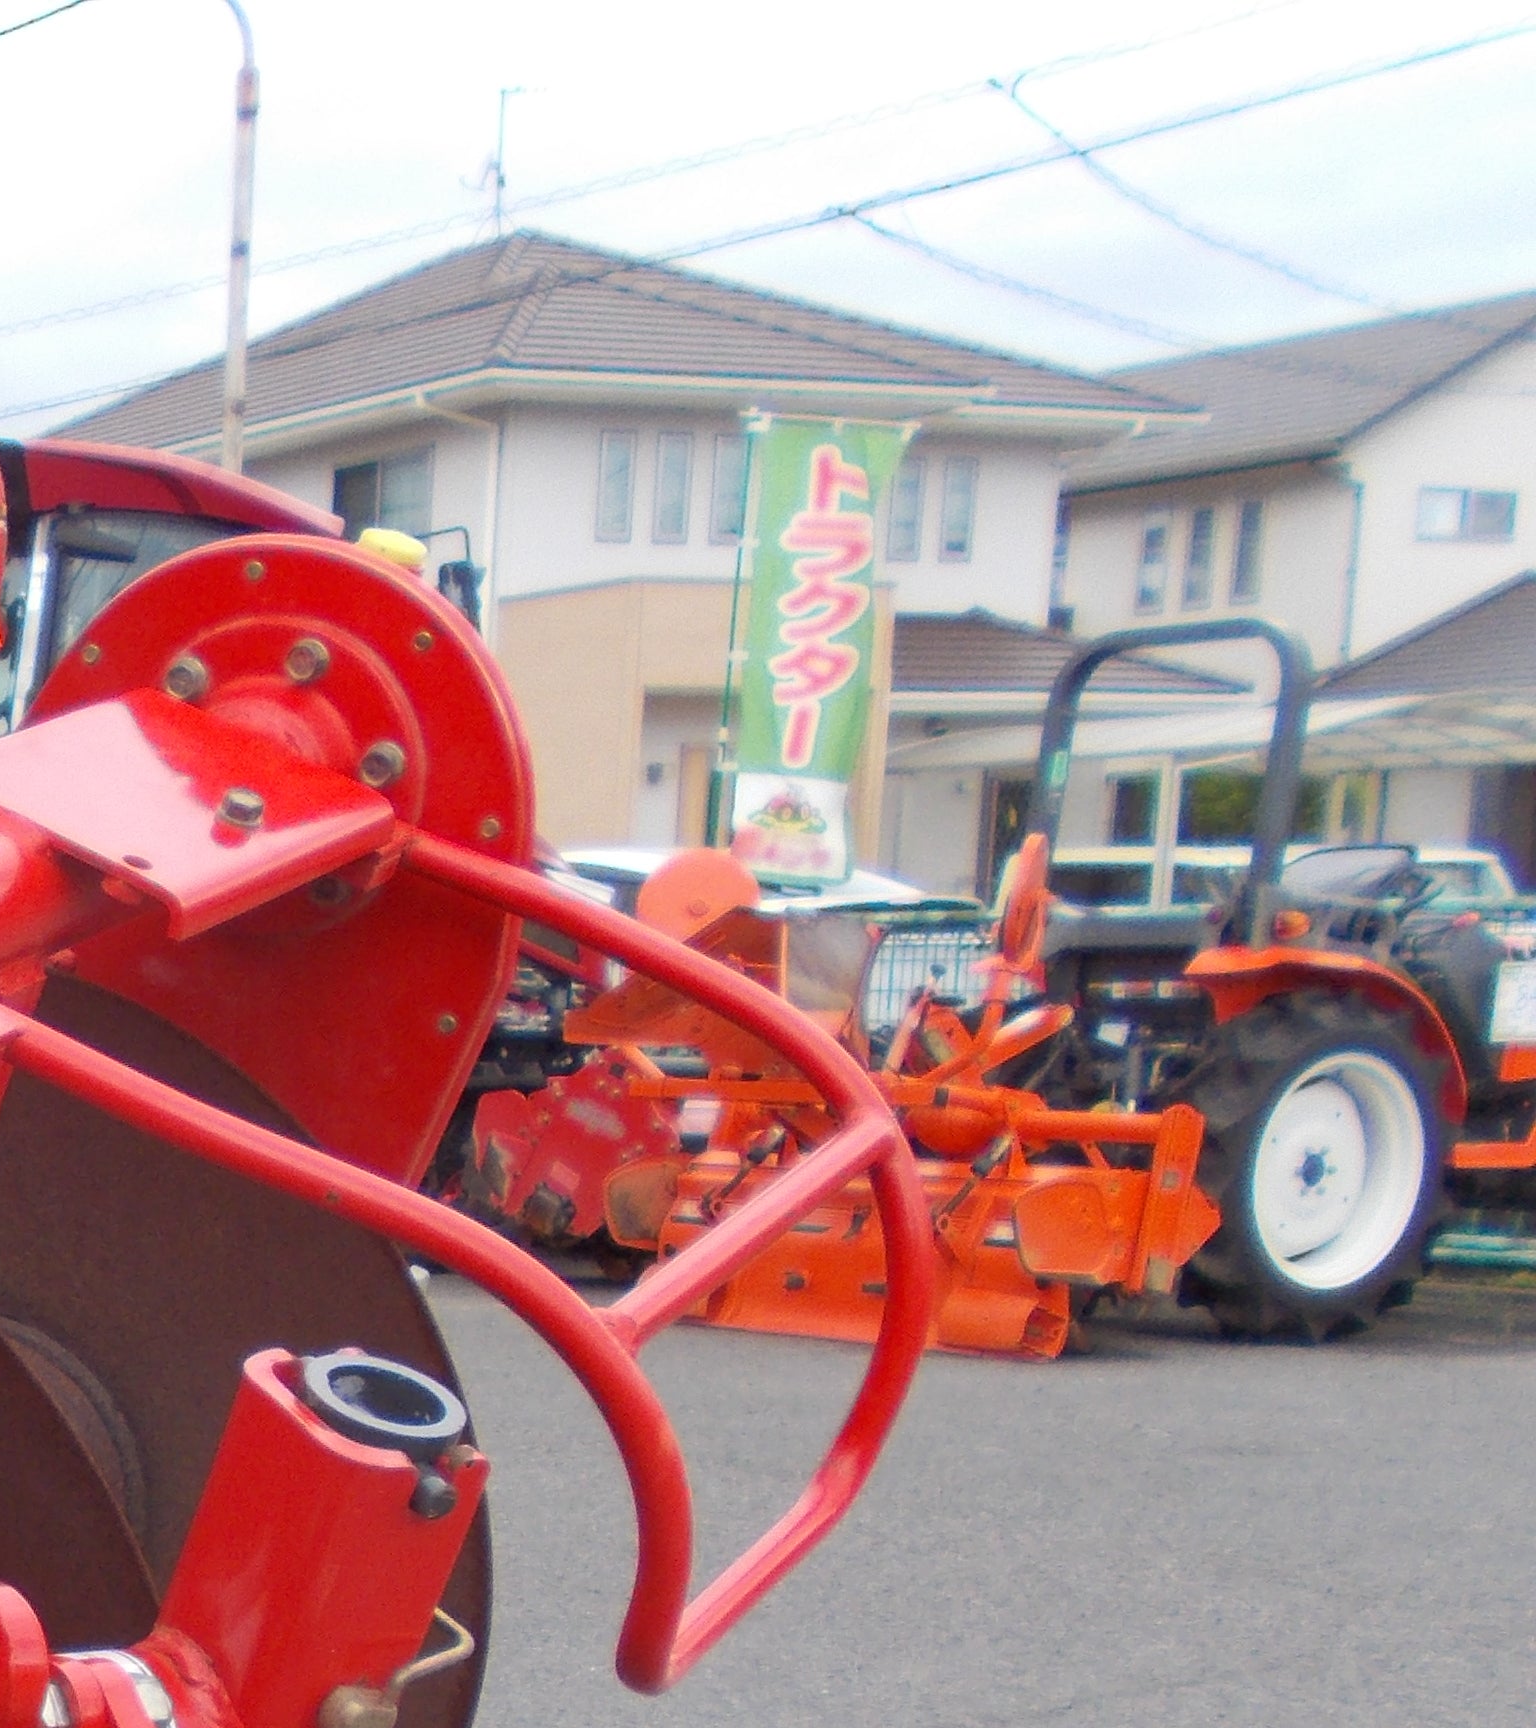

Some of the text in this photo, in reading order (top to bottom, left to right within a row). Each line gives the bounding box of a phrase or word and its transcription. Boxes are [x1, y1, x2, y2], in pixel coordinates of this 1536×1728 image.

[768, 443, 874, 768] トラクター
